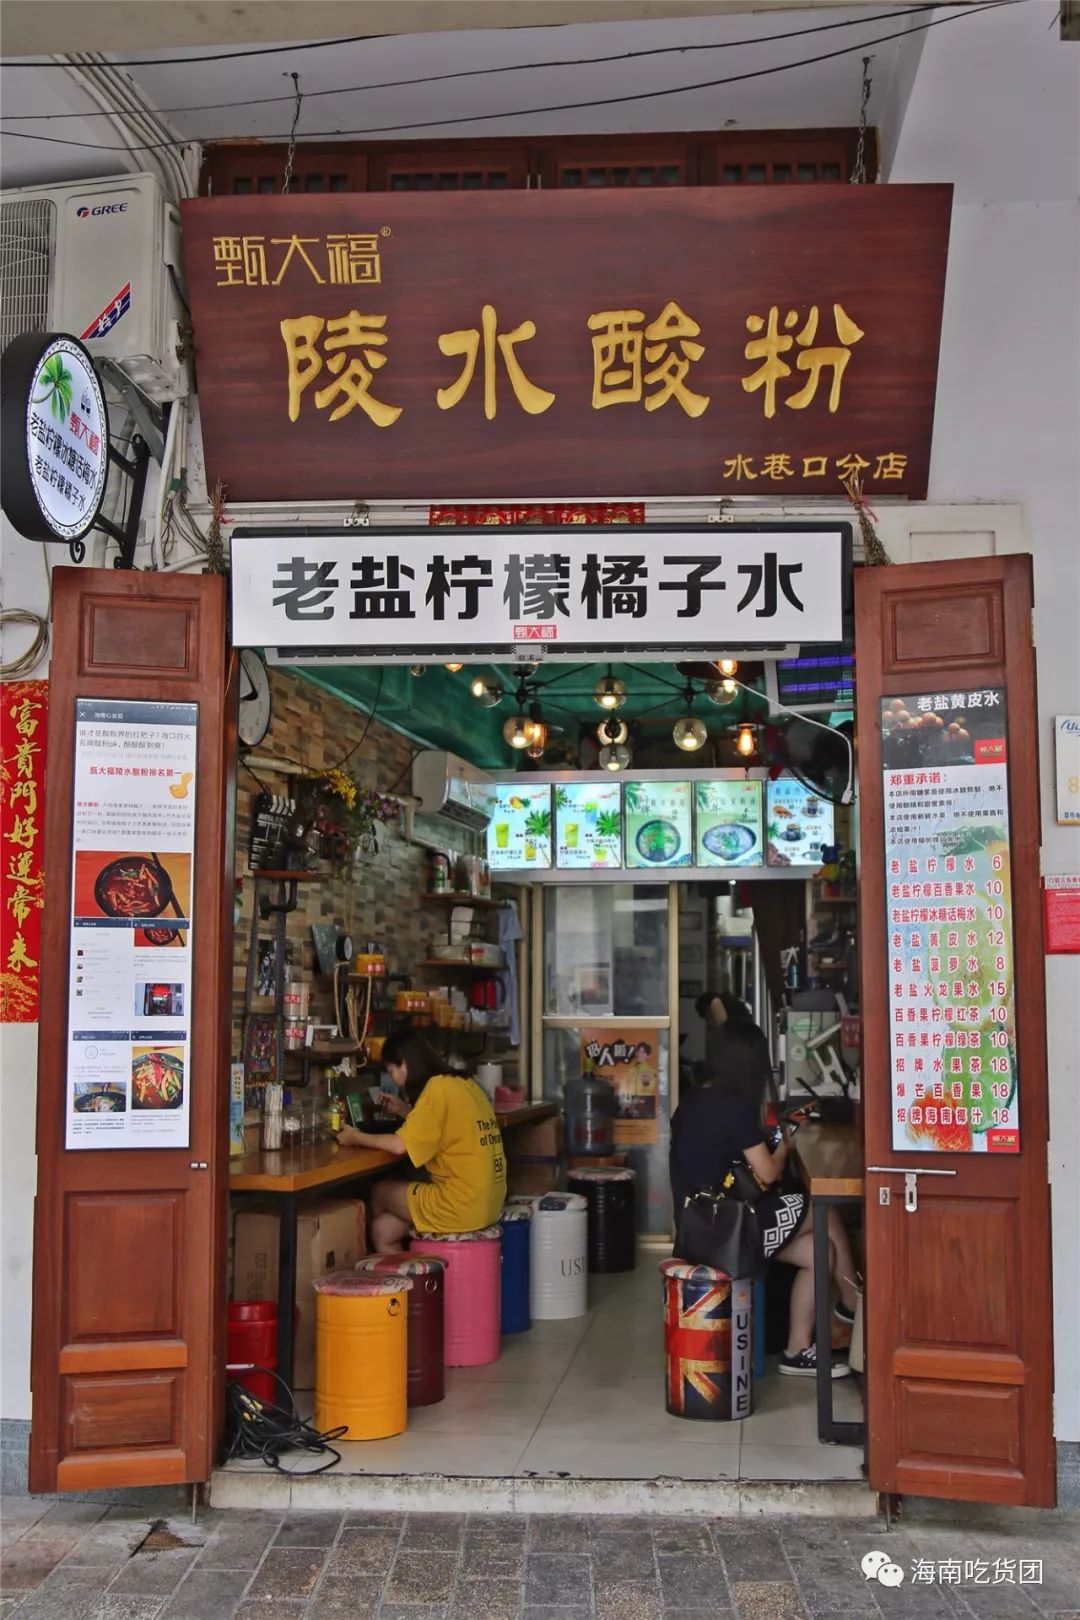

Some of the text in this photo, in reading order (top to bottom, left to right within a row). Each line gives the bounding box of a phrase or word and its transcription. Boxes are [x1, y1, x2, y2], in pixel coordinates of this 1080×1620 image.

[92, 203, 128, 216] GREE
[213, 234, 381, 286] 甄大福
[281, 302, 864, 427] 陵水酸粉
[723, 452, 908, 480] 水巷口分店
[35, 455, 86, 512] 老盐柠檬橘子水
[272, 552, 804, 620] 老盐柠檬橘子水
[515, 626, 554, 638] 甄大福
[917, 690, 1000, 711] 老盐黄皮水
[891, 856, 1001, 873] 老盐柠檬水 6
[892, 881, 1002, 898] 老盐柠檬百香果水 10
[892, 906, 1003, 923] 老盐柠檬冰糖话梅水 10
[892, 931, 1004, 947] 老盐黄皮水 12
[893, 956, 1005, 972] 老盐菠萝水 8
[894, 982, 1006, 997] 老盐火龙果水 15
[895, 1007, 1006, 1022] 百香果柠檬红茶 10
[895, 1033, 1007, 1047] 百香果柠檬绿茶 10
[896, 1058, 1008, 1072] 招牌水果茶 18
[896, 1083, 1009, 1098] 爆芒百香果 18
[897, 1108, 1009, 1123] 招牌海南椰汁 18
[477, 1119, 490, 1131] The
[736, 1313, 748, 1412] USINE
